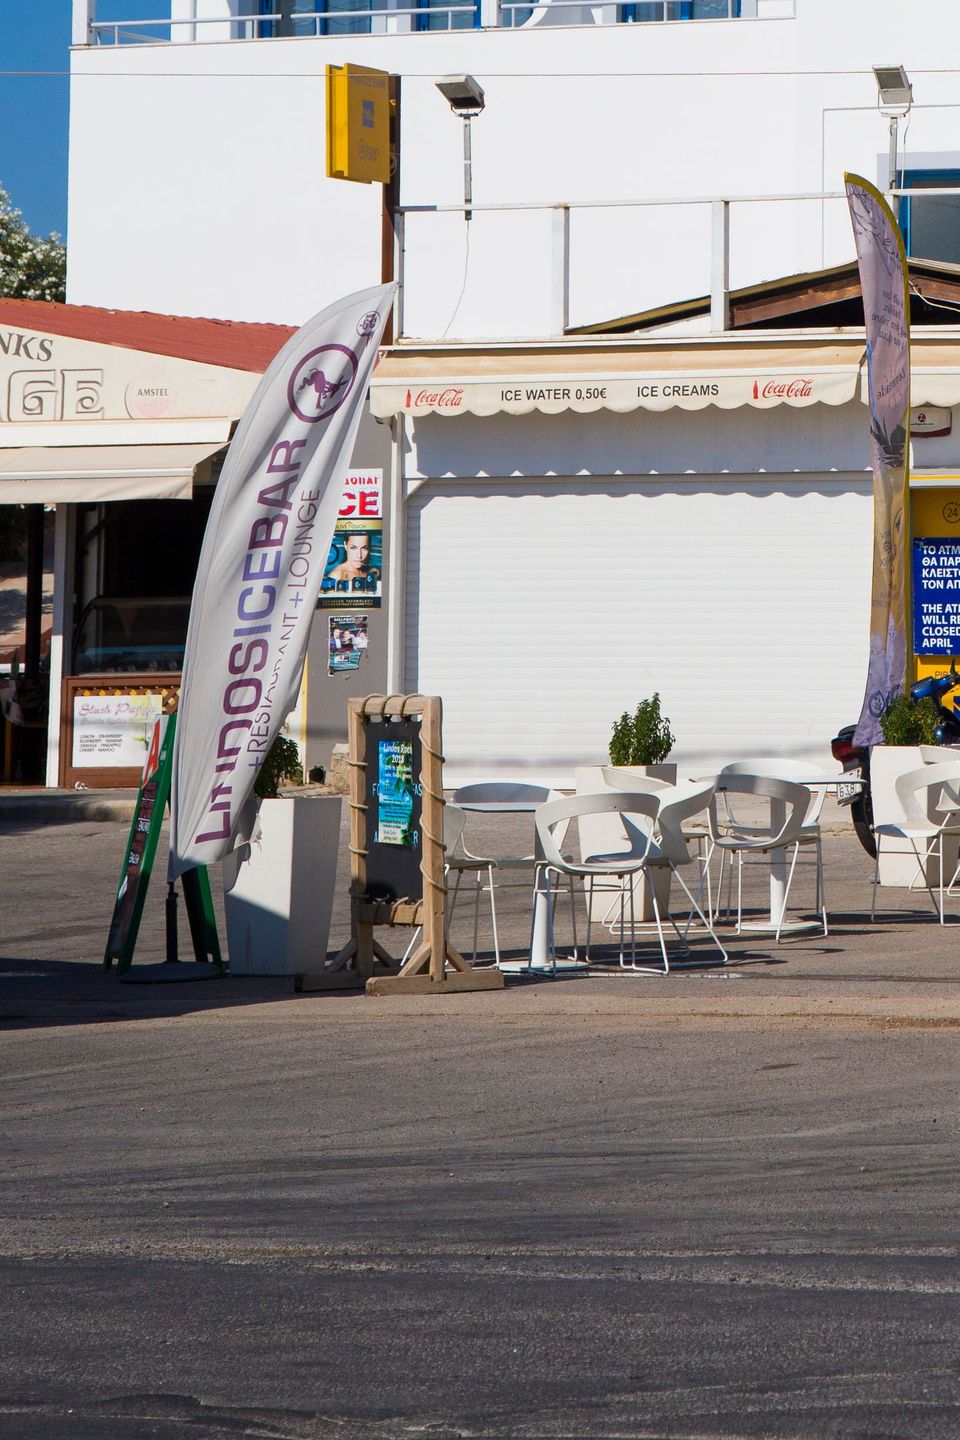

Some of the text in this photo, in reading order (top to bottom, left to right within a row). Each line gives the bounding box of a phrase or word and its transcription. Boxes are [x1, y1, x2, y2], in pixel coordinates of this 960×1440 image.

[0, 368, 104, 421] GE
[137, 388, 169, 397] AMSTEL
[501, 387, 607, 401] ICE WATER 0,50€
[637, 384, 719, 397] ICE CREAMS
[288, 489, 320, 588] LOUNGE
[922, 557, 937, 566] ΘΑ
[922, 580, 944, 589] ΤΟΝ
[922, 604, 942, 613] THE
[922, 615, 948, 624] WILL
[922, 638, 953, 647] APRIL
